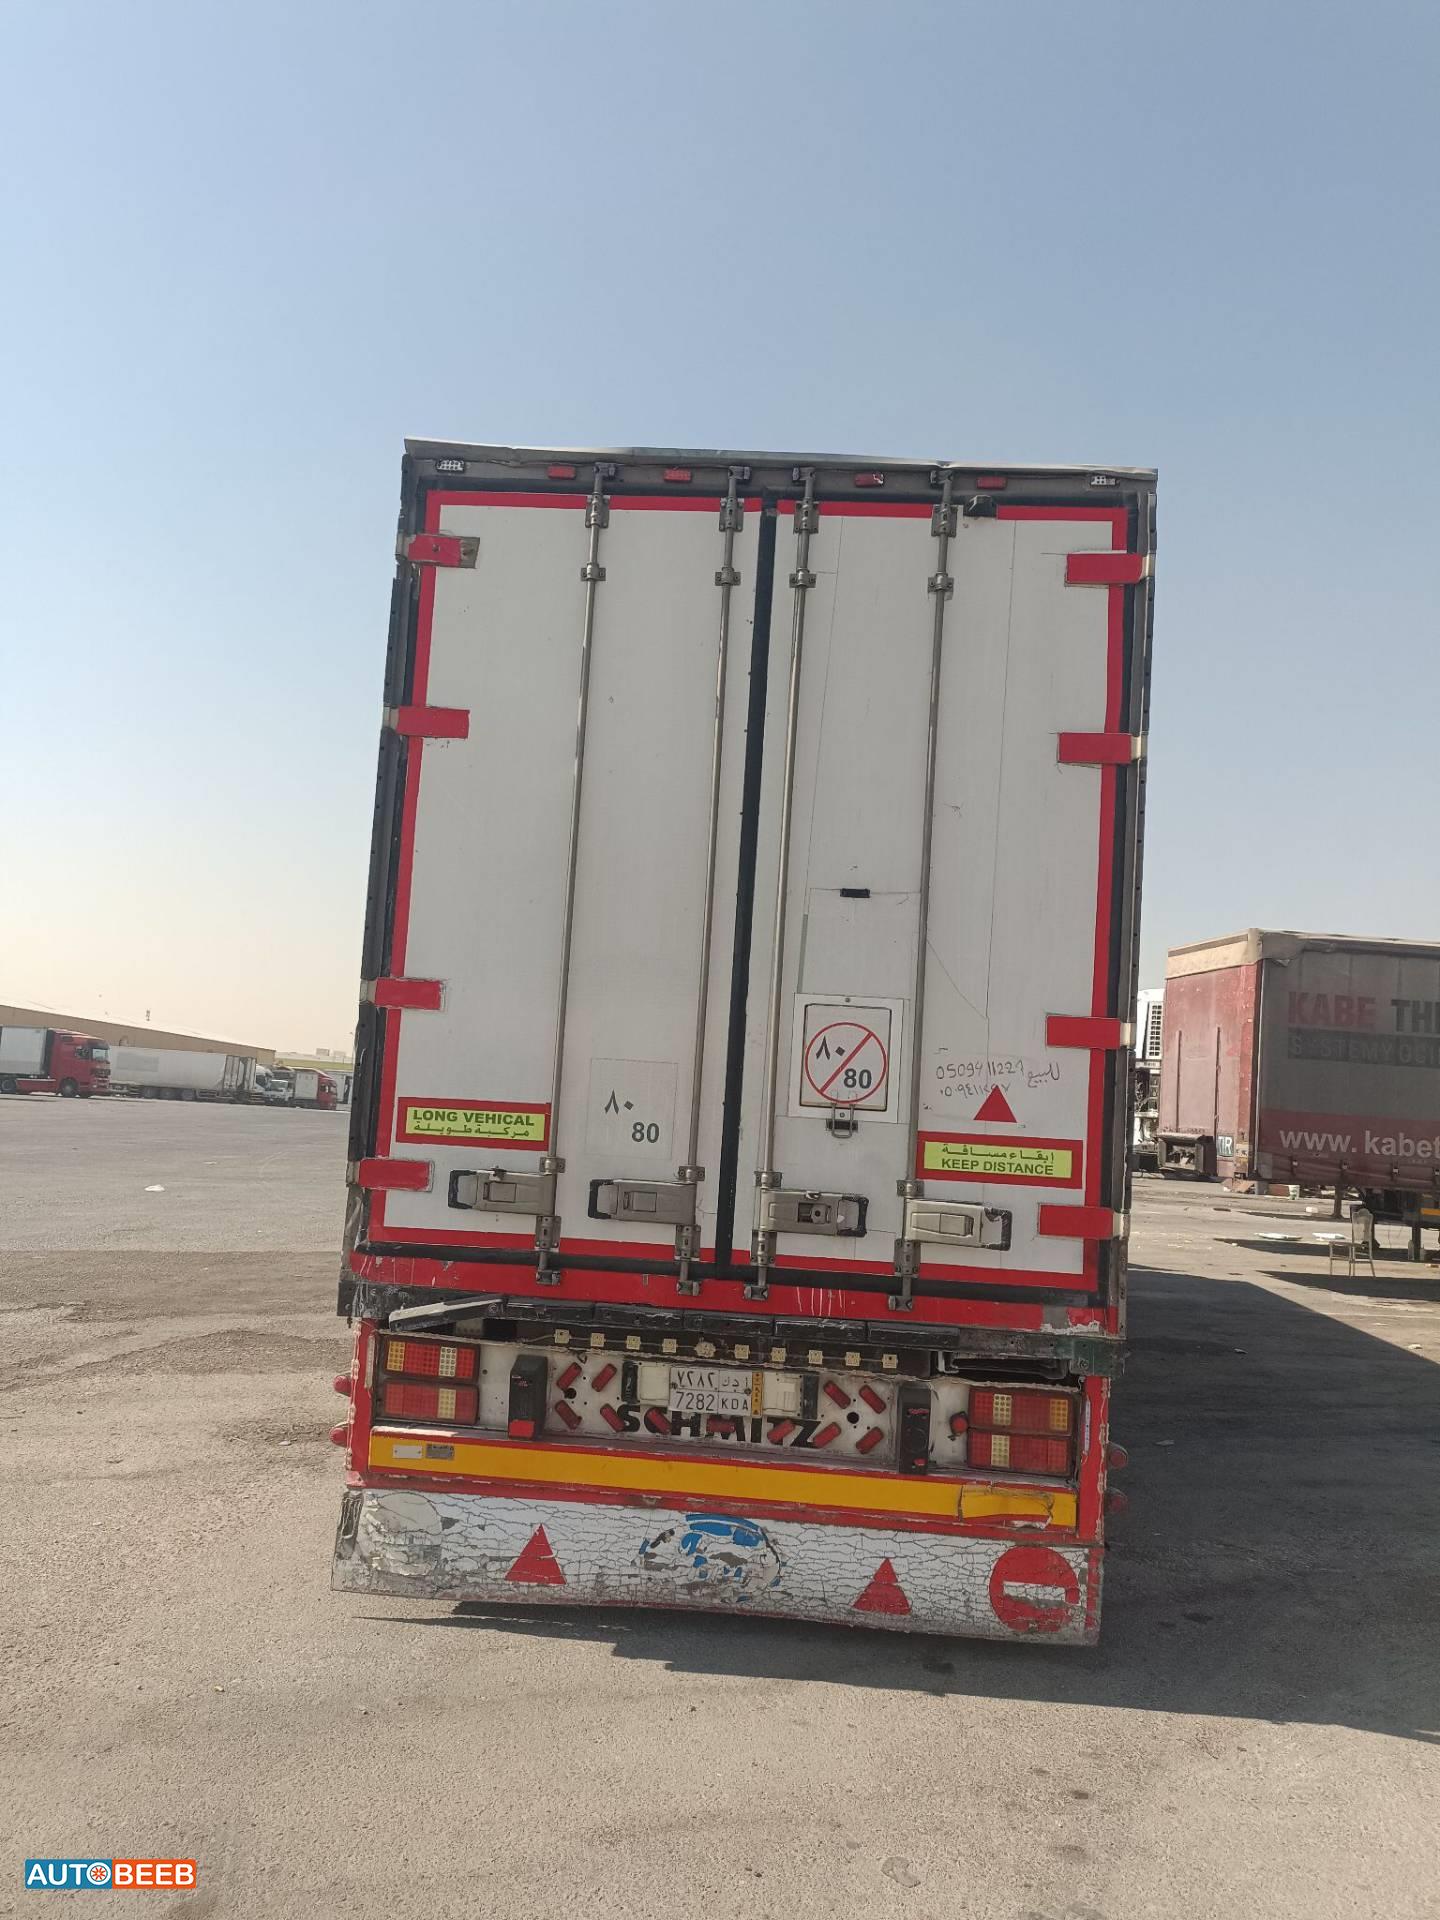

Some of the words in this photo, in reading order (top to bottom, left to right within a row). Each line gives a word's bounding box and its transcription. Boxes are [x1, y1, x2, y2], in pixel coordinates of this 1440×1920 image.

[1391, 999, 1440, 1034] TH
[816, 1035, 846, 1060] ٨٠
[843, 1068, 872, 1089] 80
[604, 1089, 634, 1114] ٨٠
[413, 1109, 458, 1122] LONG
[463, 1112, 535, 1126] VEHICAL
[414, 1120, 472, 1135] طويلة
[475, 1124, 530, 1138] مركبة
[631, 1121, 660, 1143] 80
[1278, 1129, 1357, 1153] www.
[941, 1158, 979, 1170] KEEP
[983, 1161, 1054, 1175] DISTANCE
[677, 1370, 715, 1388] ٧٢٨٢
[675, 1391, 715, 1412] 7282
